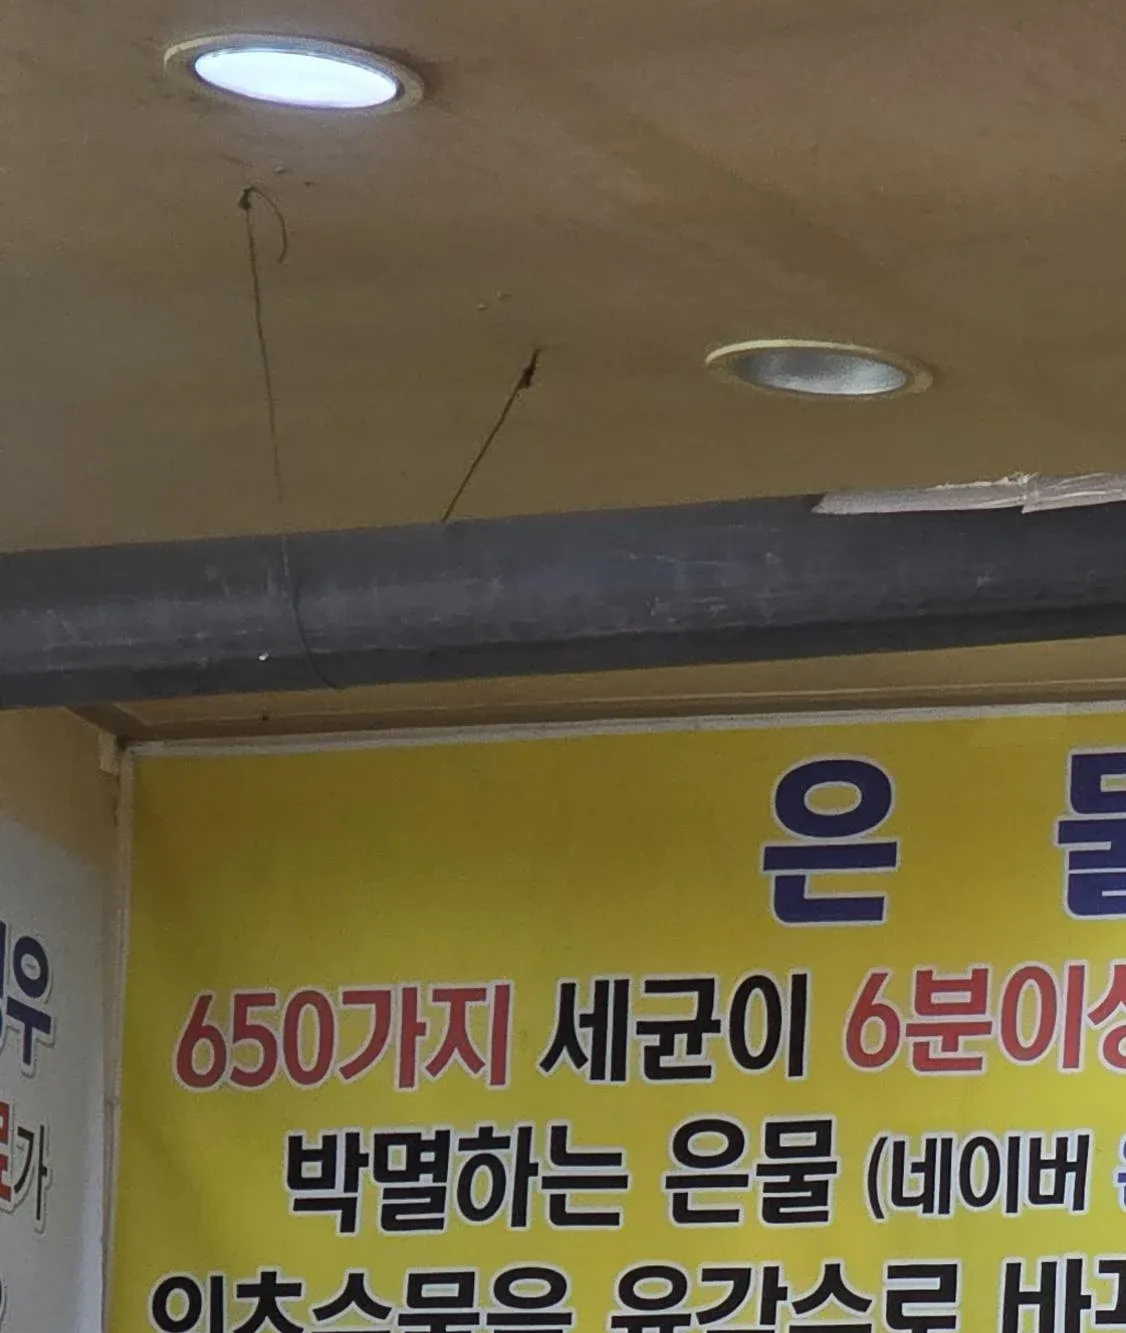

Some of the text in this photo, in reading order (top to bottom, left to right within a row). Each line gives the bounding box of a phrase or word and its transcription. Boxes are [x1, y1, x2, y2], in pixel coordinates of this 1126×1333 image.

[764, 760, 897, 922] 은
[177, 984, 510, 1088] 650가지
[540, 973, 807, 1081] 세균이
[287, 1125, 628, 1233] 박멸하는
[666, 1119, 837, 1223] 은물
[868, 1135, 1089, 1218] (네이버
